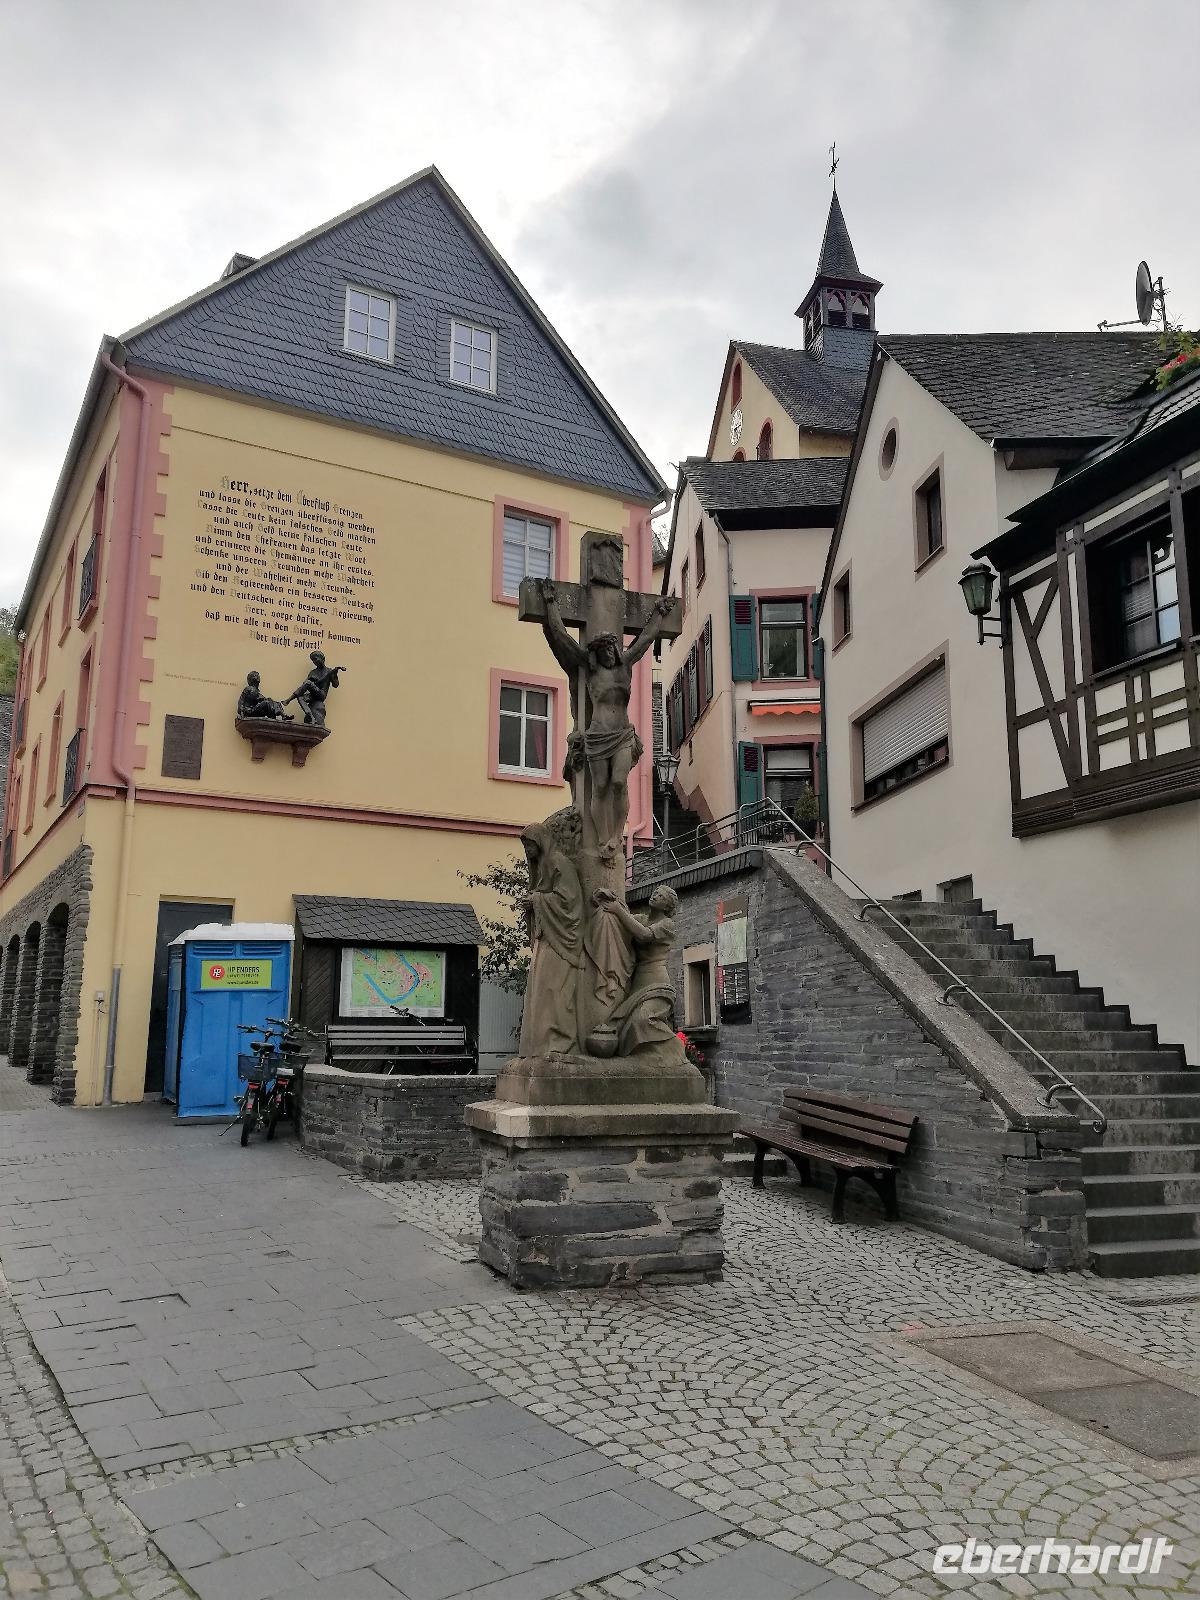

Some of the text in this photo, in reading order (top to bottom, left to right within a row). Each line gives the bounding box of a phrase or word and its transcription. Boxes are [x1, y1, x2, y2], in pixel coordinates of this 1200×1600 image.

[254, 488, 274, 500] setze
[277, 489, 292, 503] dem
[200, 490, 216, 498] und
[218, 493, 241, 505] lasse
[244, 498, 256, 508] die
[298, 510, 344, 528] überflüssig
[348, 522, 375, 534] werden
[226, 506, 238, 516] die
[268, 515, 286, 526] kein
[290, 519, 323, 533] falsches
[348, 533, 376, 544] machen
[214, 516, 230, 524] und
[234, 520, 254, 531] auch
[278, 528, 300, 540] keine
[304, 533, 336, 548] falschen
[236, 530, 250, 540] den
[300, 543, 314, 554] das
[318, 547, 342, 560] letzte
[196, 536, 212, 544] und
[216, 540, 250, 552] erinnere
[254, 546, 266, 555] die
[334, 560, 344, 570] ihr
[233, 554, 266, 566] unseren
[314, 570, 334, 580] mehr
[214, 572, 228, 582] den
[288, 587, 300, 596] ein
[304, 588, 336, 602] besseres
[216, 562, 232, 572] und
[236, 564, 248, 574] der
[296, 578, 316, 588] mehr
[190, 583, 206, 592] und
[210, 585, 224, 596] den
[278, 598, 294, 608] eine
[298, 601, 328, 614] bessere
[206, 609, 220, 620] daß
[224, 614, 240, 624] wir
[244, 617, 258, 626] alle
[262, 620, 270, 628] in
[274, 622, 288, 632] den
[328, 630, 360, 644] kommen
[271, 611, 293, 622] sorge
[272, 634, 290, 647] nicht
